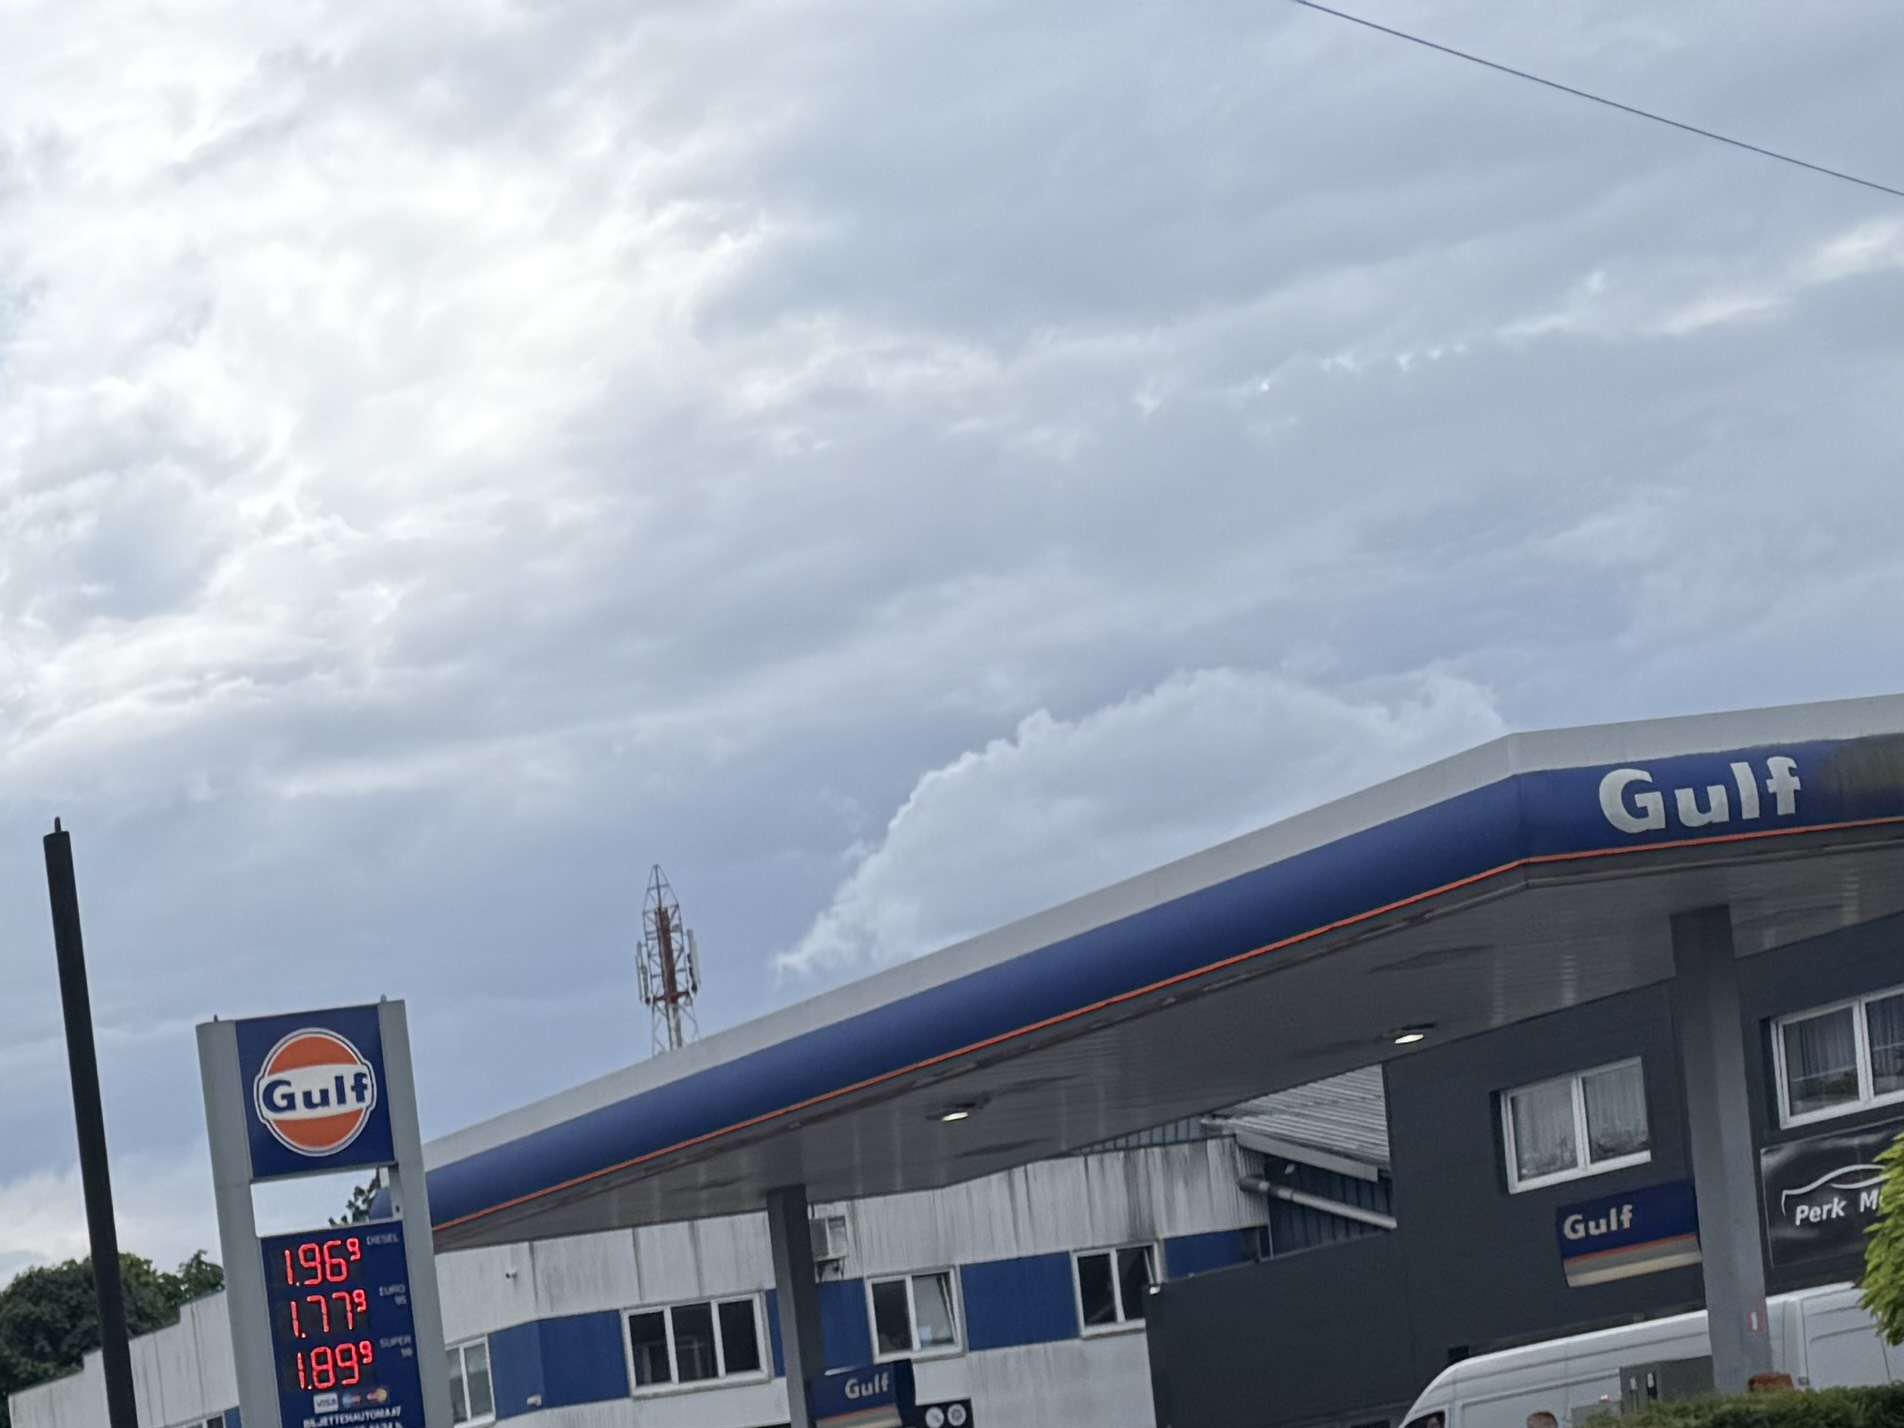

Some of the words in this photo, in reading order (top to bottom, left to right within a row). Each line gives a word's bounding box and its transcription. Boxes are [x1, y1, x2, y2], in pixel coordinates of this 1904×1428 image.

[1598, 756, 1802, 834] Gulf
[262, 1072, 369, 1113] Gulf
[1563, 1203, 1633, 1240] Gulf
[1795, 1197, 1847, 1226] Perk
[1859, 1189, 1883, 1212] M
[366, 1233, 398, 1245] DIESEL
[379, 1284, 406, 1296] EURO
[380, 1336, 412, 1347] SUPER
[845, 1372, 890, 1399] Gulf
